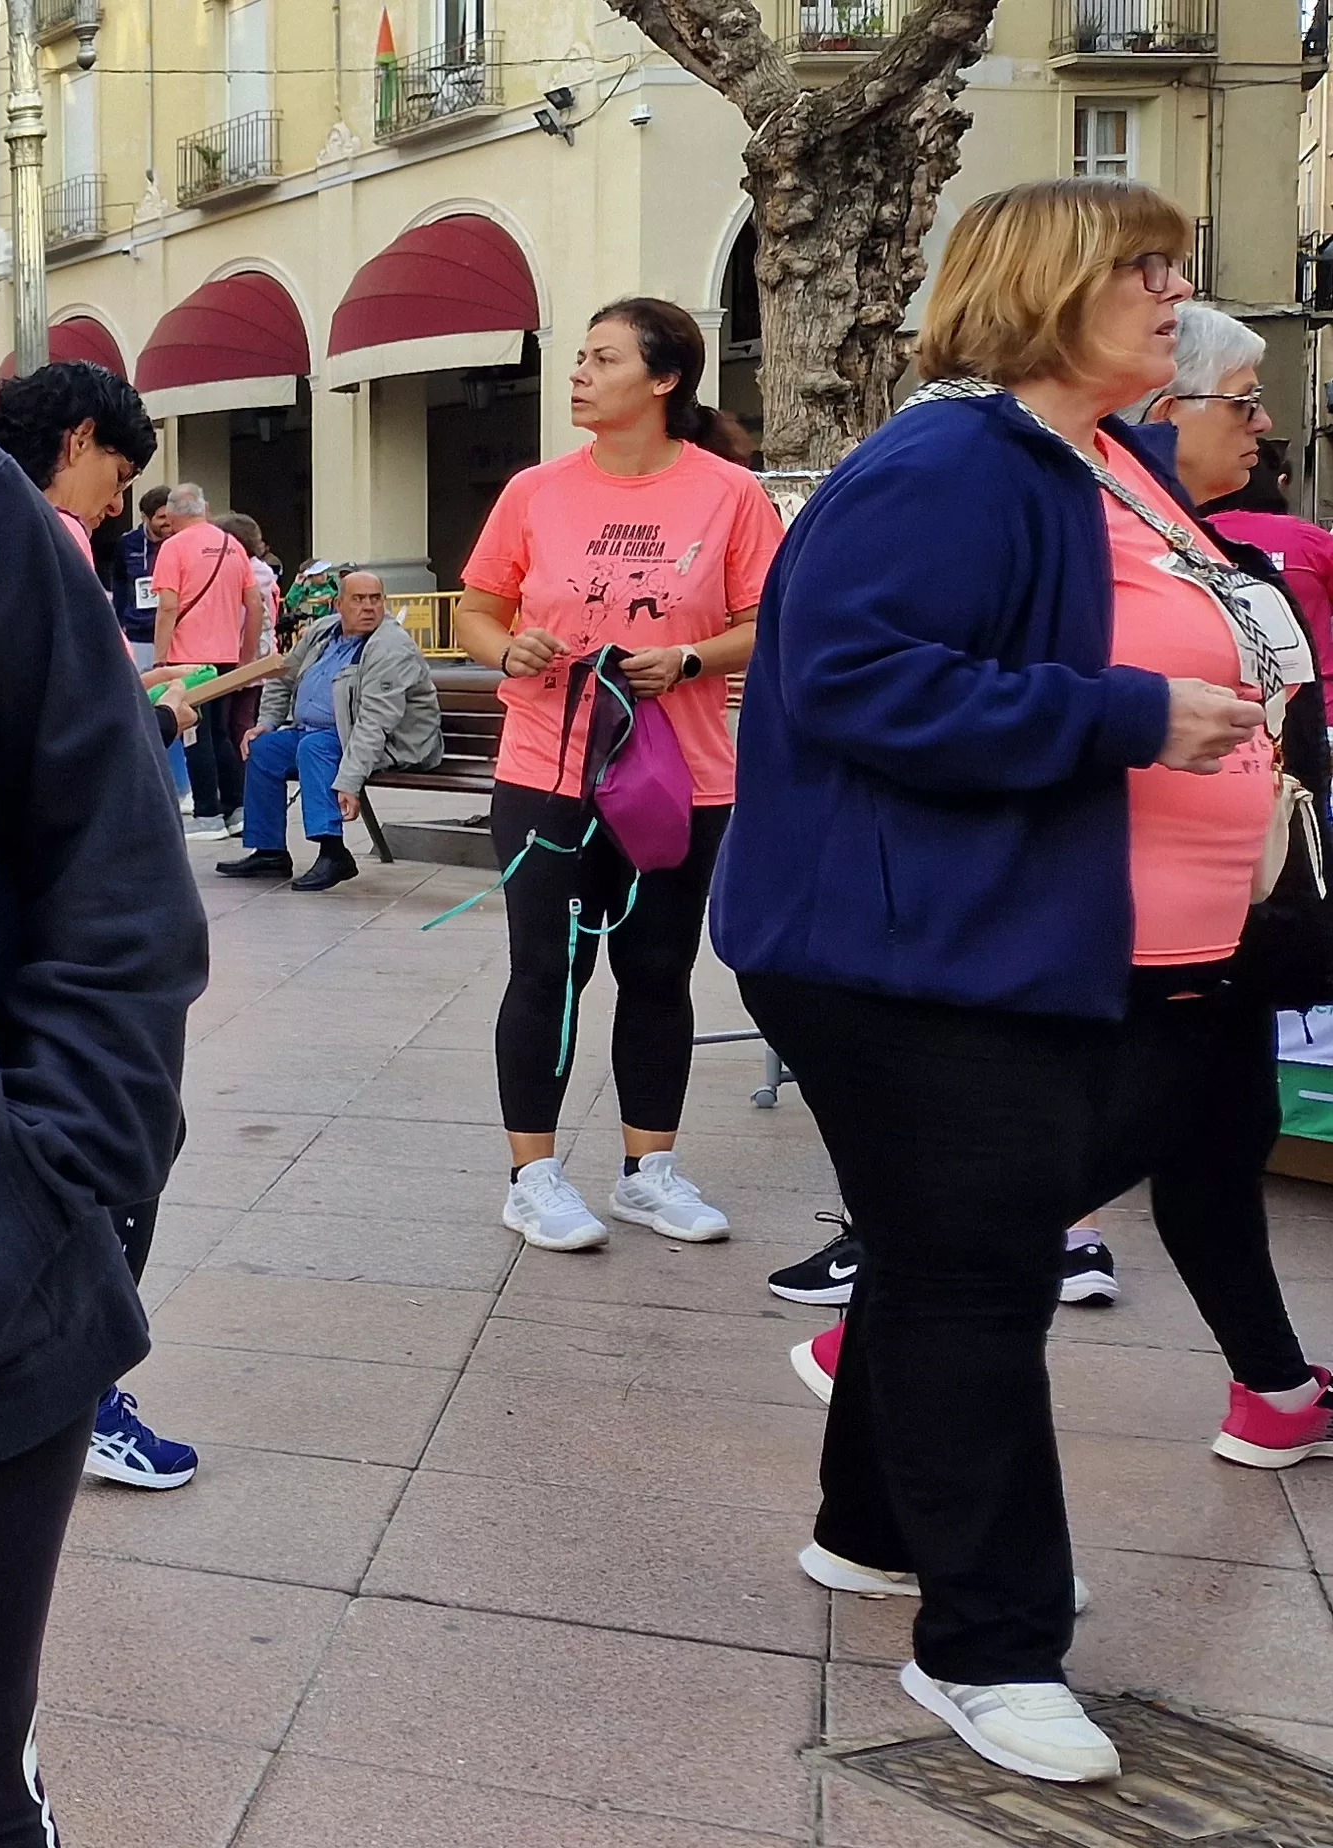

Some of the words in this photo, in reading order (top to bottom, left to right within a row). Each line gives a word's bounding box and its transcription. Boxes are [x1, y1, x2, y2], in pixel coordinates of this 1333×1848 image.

[600, 523, 661, 541] CORRAMOS
[585, 540, 608, 556] POR
[608, 541, 622, 556] LA
[623, 541, 666, 558] CIENCIA
